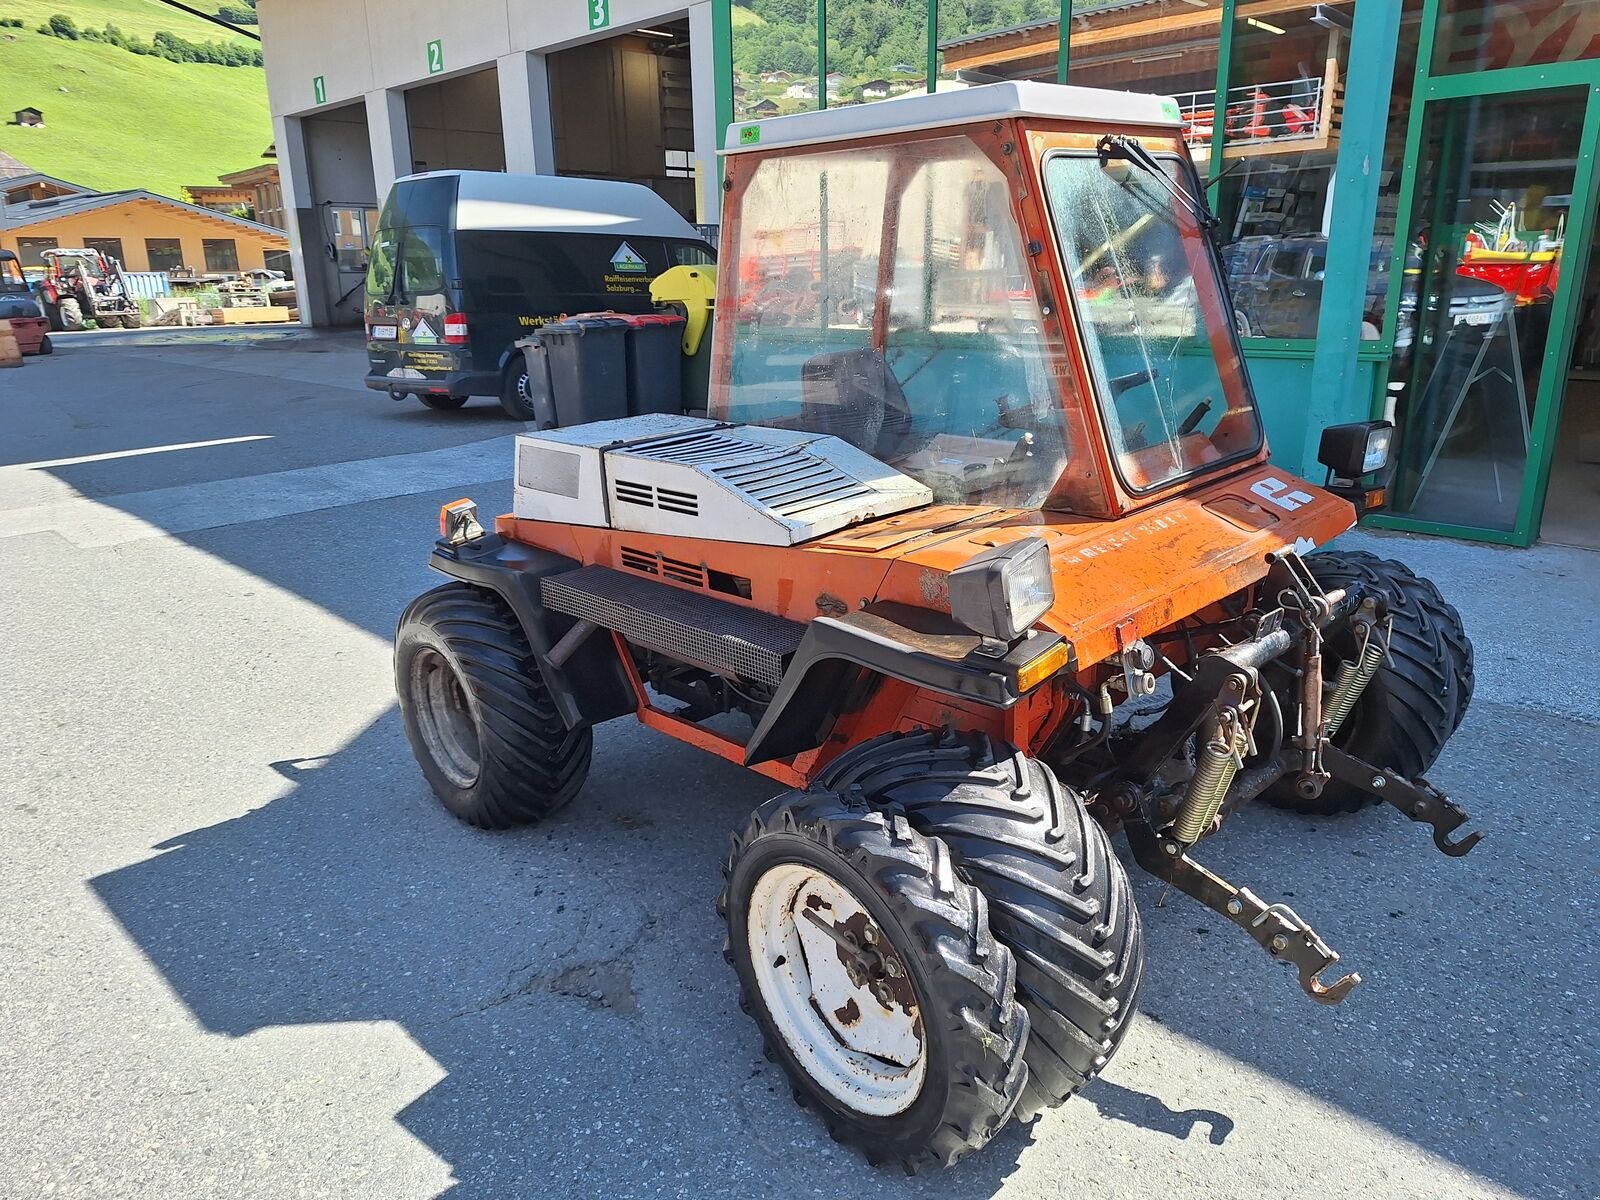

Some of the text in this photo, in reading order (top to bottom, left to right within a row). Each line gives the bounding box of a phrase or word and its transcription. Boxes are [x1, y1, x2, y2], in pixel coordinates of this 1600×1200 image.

[592, 0, 605, 26] 3
[429, 42, 441, 71] 2
[315, 78, 324, 101] 1
[606, 284, 635, 293] Salzburg
